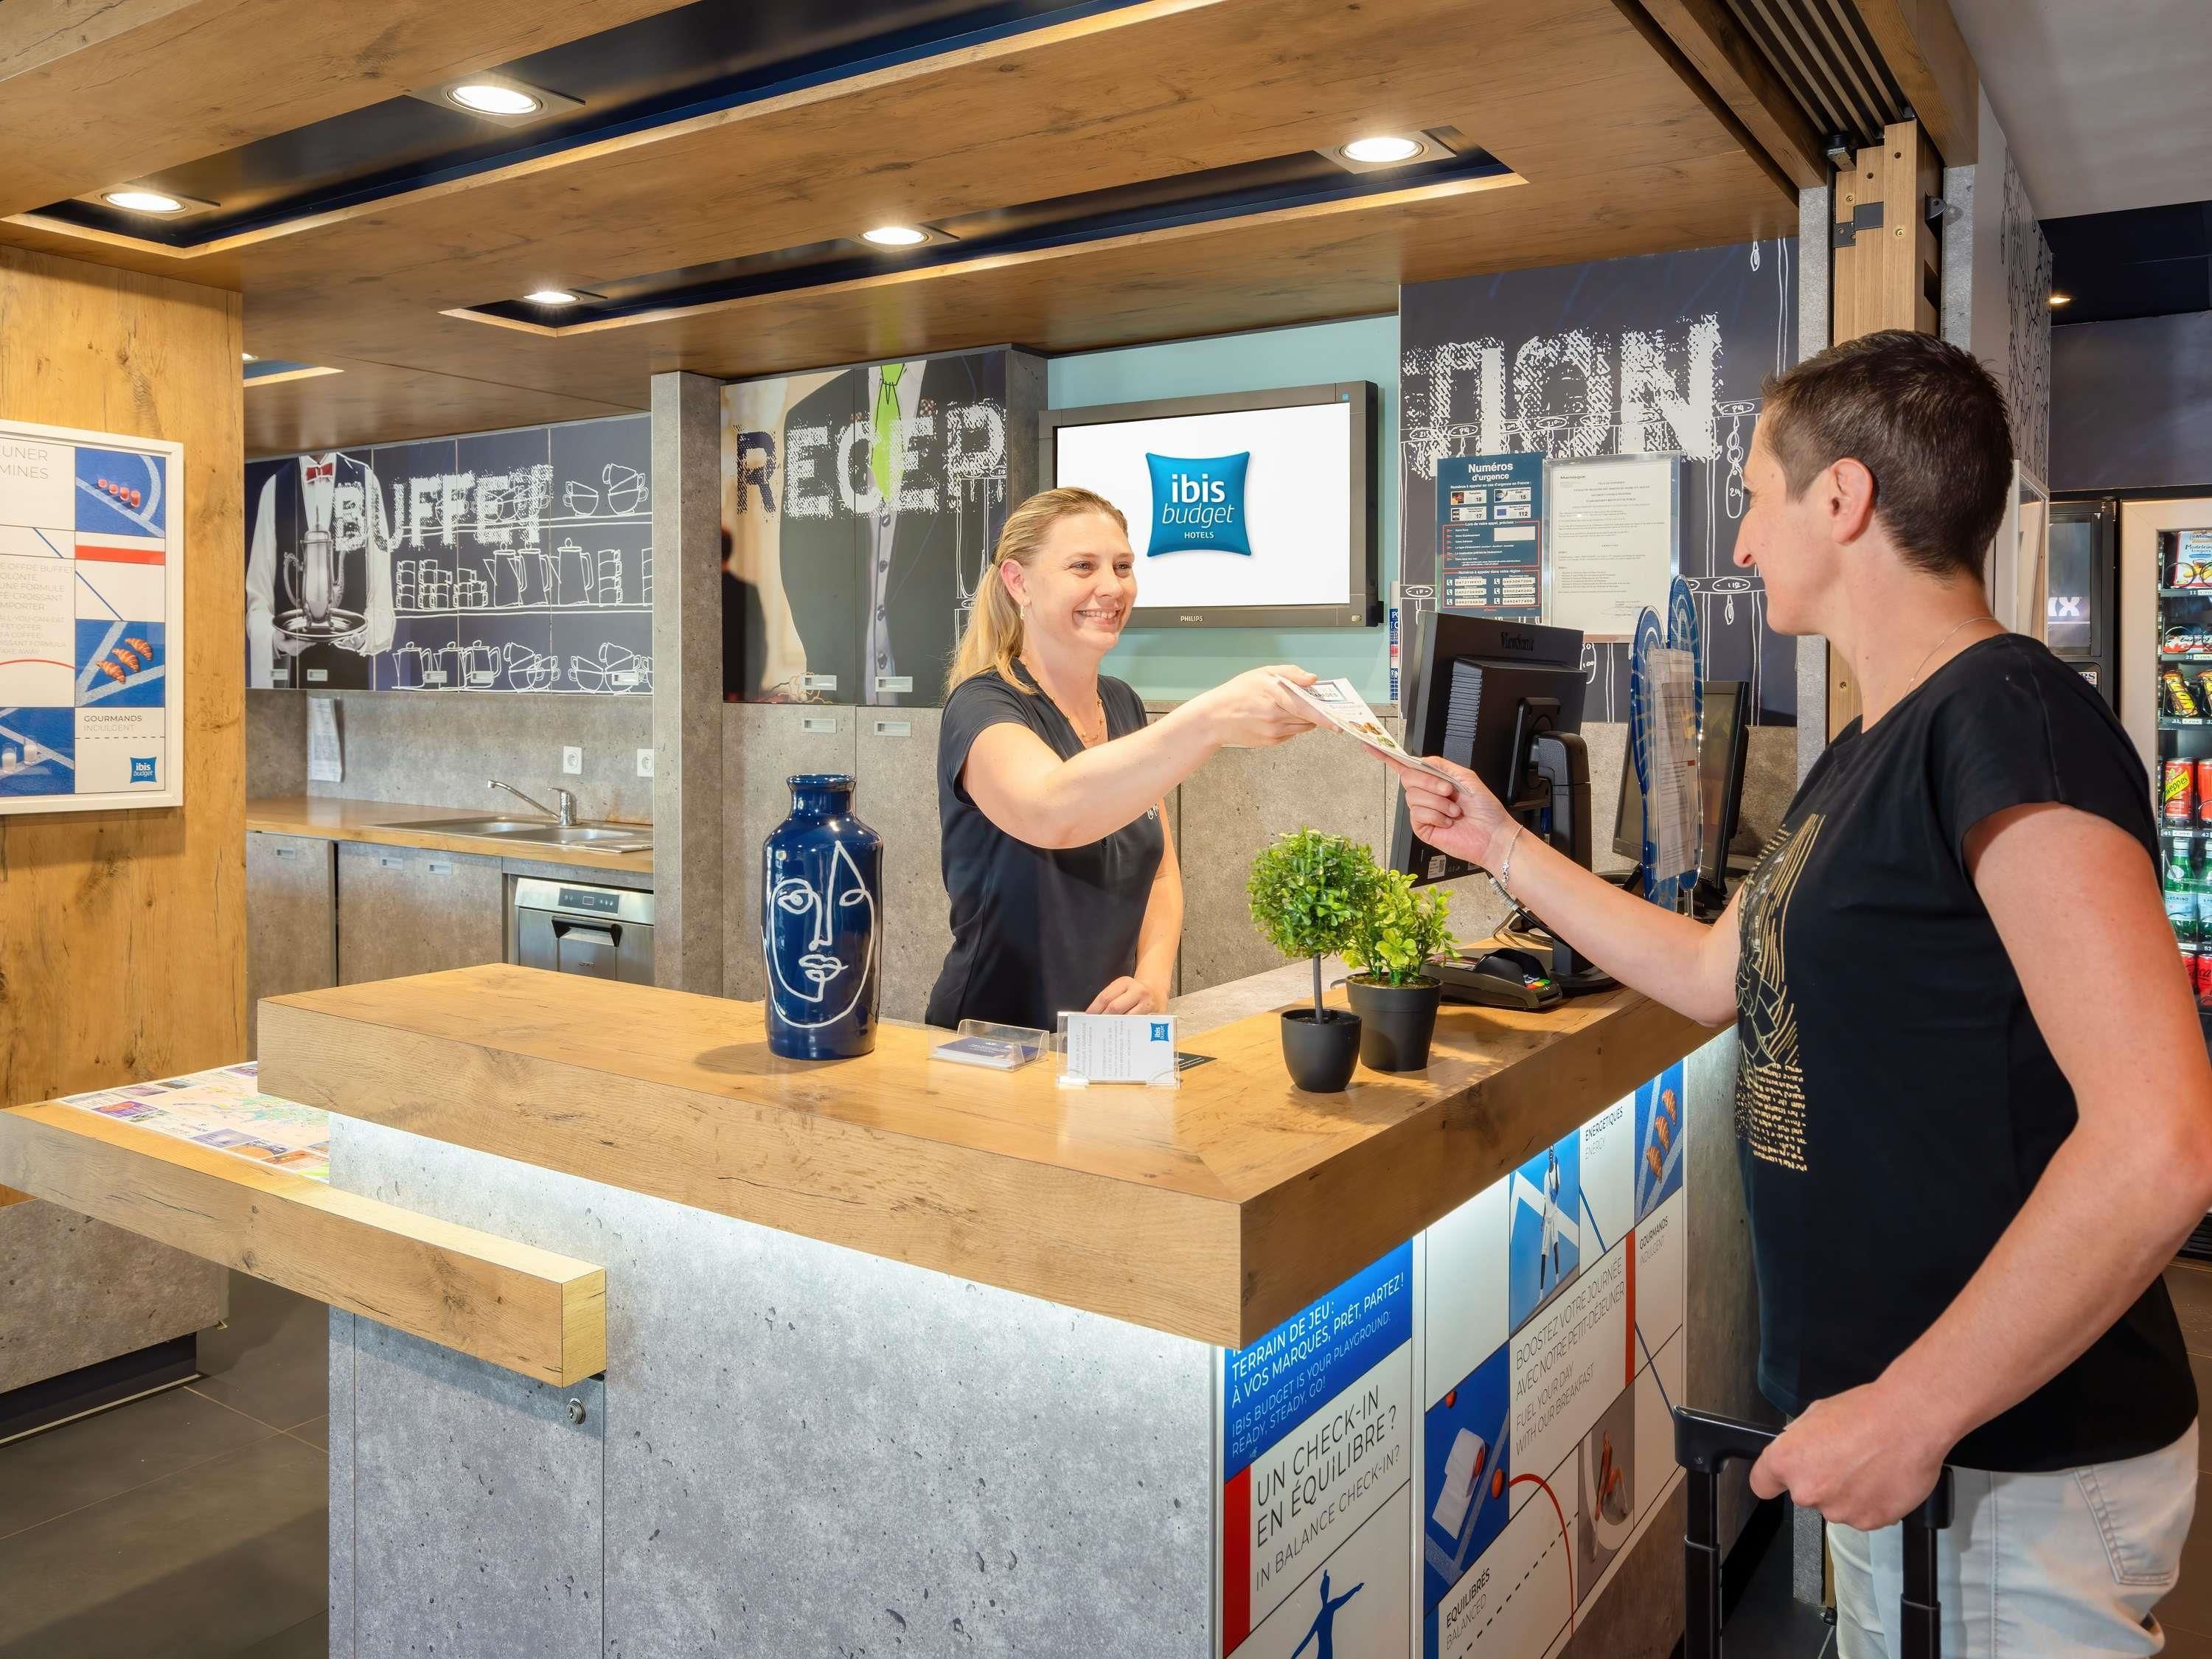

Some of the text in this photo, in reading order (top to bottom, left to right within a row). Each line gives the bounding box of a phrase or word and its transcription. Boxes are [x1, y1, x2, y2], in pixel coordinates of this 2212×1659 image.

[735, 402, 1006, 518] RECEP
[1171, 473, 1225, 503] ibis
[1468, 462, 1514, 473] Numéros
[1472, 473, 1509, 481] d'urgence
[333, 465, 553, 552] BUFFET
[1162, 503, 1235, 529] budget
[133, 770, 153, 778] budget
[136, 762, 151, 771] ibis
[1640, 1216, 1669, 1250] GOURMANDS
[1516, 1256, 1623, 1371] BOOSTEZ VOTRE JOURNÉE
[1232, 1331, 1286, 1382] TERRAIN
[1290, 1318, 1306, 1343] DE
[1232, 1385, 1241, 1409] À
[1244, 1367, 1269, 1397] VOS
[1273, 1325, 1331, 1379] MARQUES,
[1334, 1302, 1362, 1334] PRÊT,
[1232, 1311, 1391, 1438] IBIS BUDGET IS YOUR PLAYGROUND:
[1516, 1363, 1540, 1402] AVEC
[1540, 1338, 1566, 1379] NOTRE
[1232, 1376, 1326, 1458] READY, STEADY, GO!
[1516, 1362, 1573, 1431] FUEL YOUR DAY
[1516, 1362, 1594, 1456] WITH OUR BREAKFAST
[1258, 1385, 1378, 1506] UN CHECK-IN
[1257, 1444, 1399, 1592] IN BALANCE CHECK-IN?
[1258, 1500, 1282, 1548] EN
[1447, 1567, 1490, 1629] EQUILIBRÉS
[1447, 1593, 1486, 1650] BALANCED
